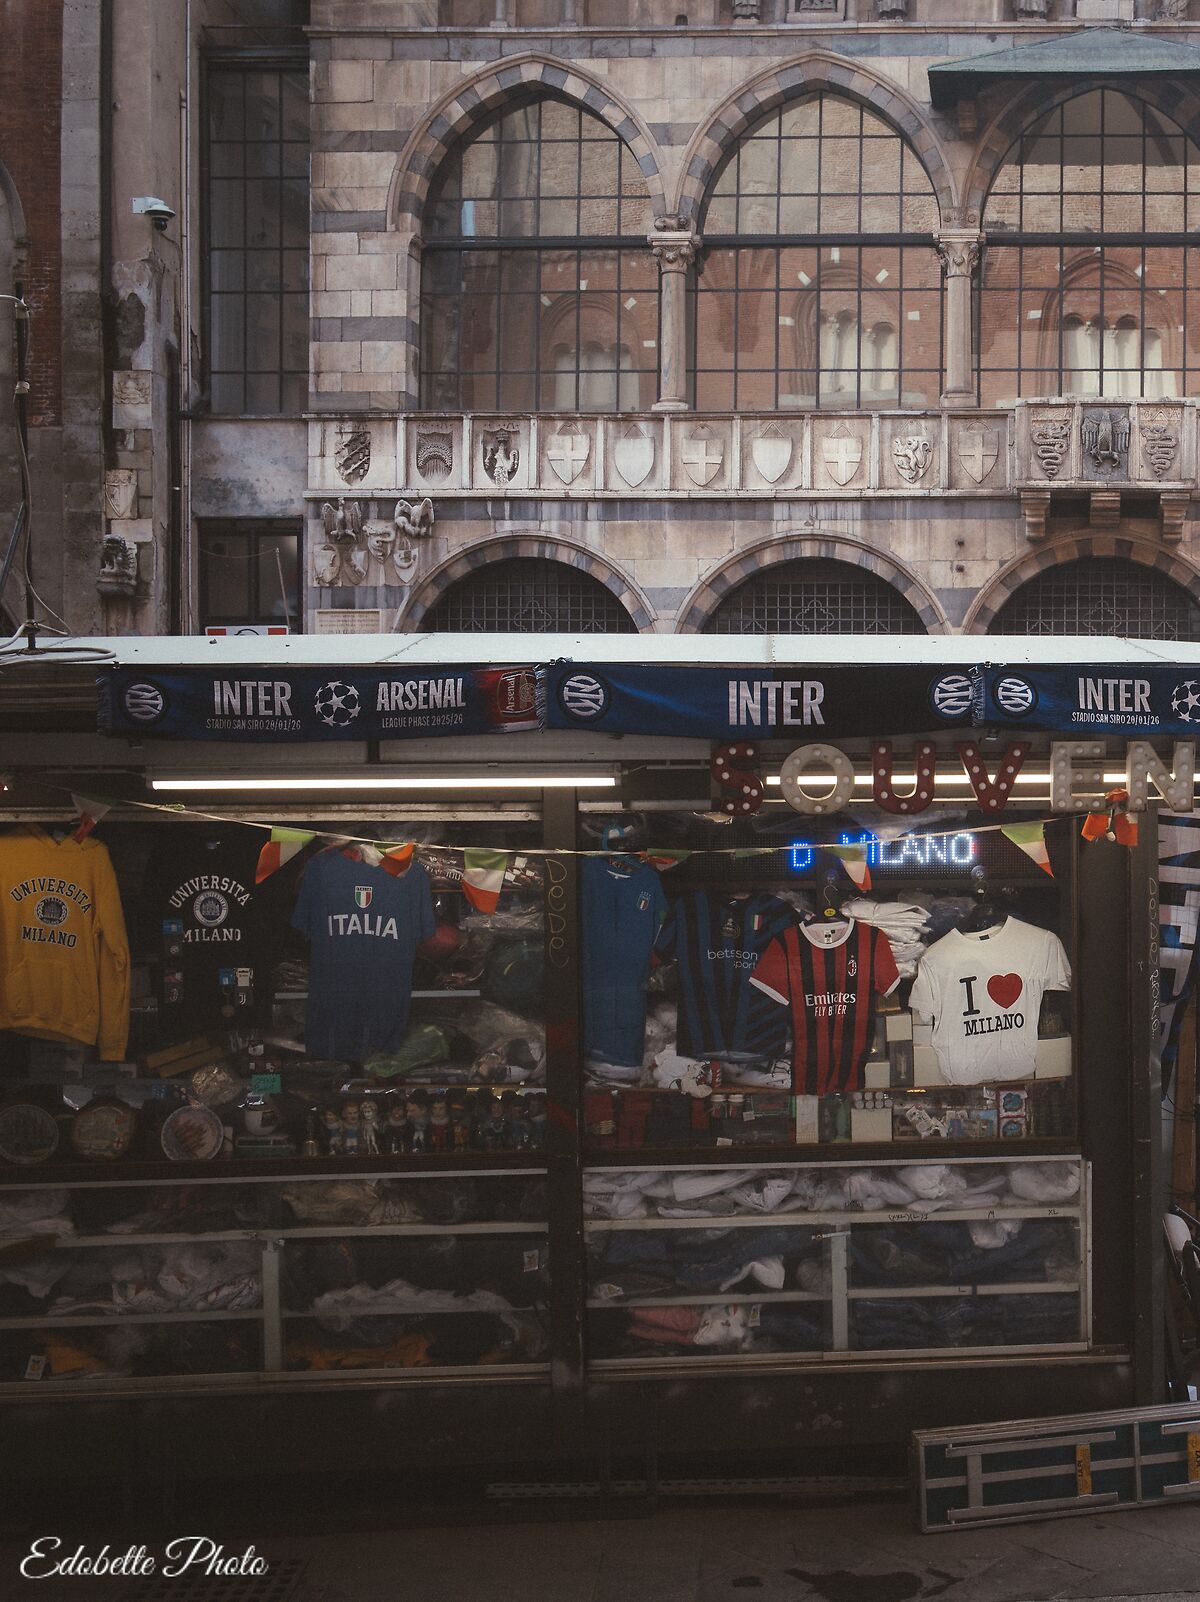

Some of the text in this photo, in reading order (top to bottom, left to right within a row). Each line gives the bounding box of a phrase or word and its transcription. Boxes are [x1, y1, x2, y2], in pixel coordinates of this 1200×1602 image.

[213, 680, 293, 716] INTER
[376, 677, 467, 712] ARSENAL
[505, 677, 515, 711] Arsenal
[728, 680, 825, 725] INTER
[1078, 677, 1152, 712] INTER
[206, 719, 232, 729] STADIO
[233, 719, 246, 730] SAN
[248, 719, 264, 730] SIRO
[382, 713, 463, 728] LEAGUE PHASE 2025/26
[1072, 712, 1096, 723] STADIO
[1096, 713, 1109, 723] SAN
[1110, 714, 1126, 724] SIRO
[21, 926, 78, 948] MILANO
[327, 913, 399, 940] ITALIA
[707, 948, 758, 960] betsson
[804, 991, 857, 1007] Emirates
[959, 975, 981, 1017] I
[815, 1006, 827, 1017] FLY
[963, 1012, 1025, 1036] MILANO
